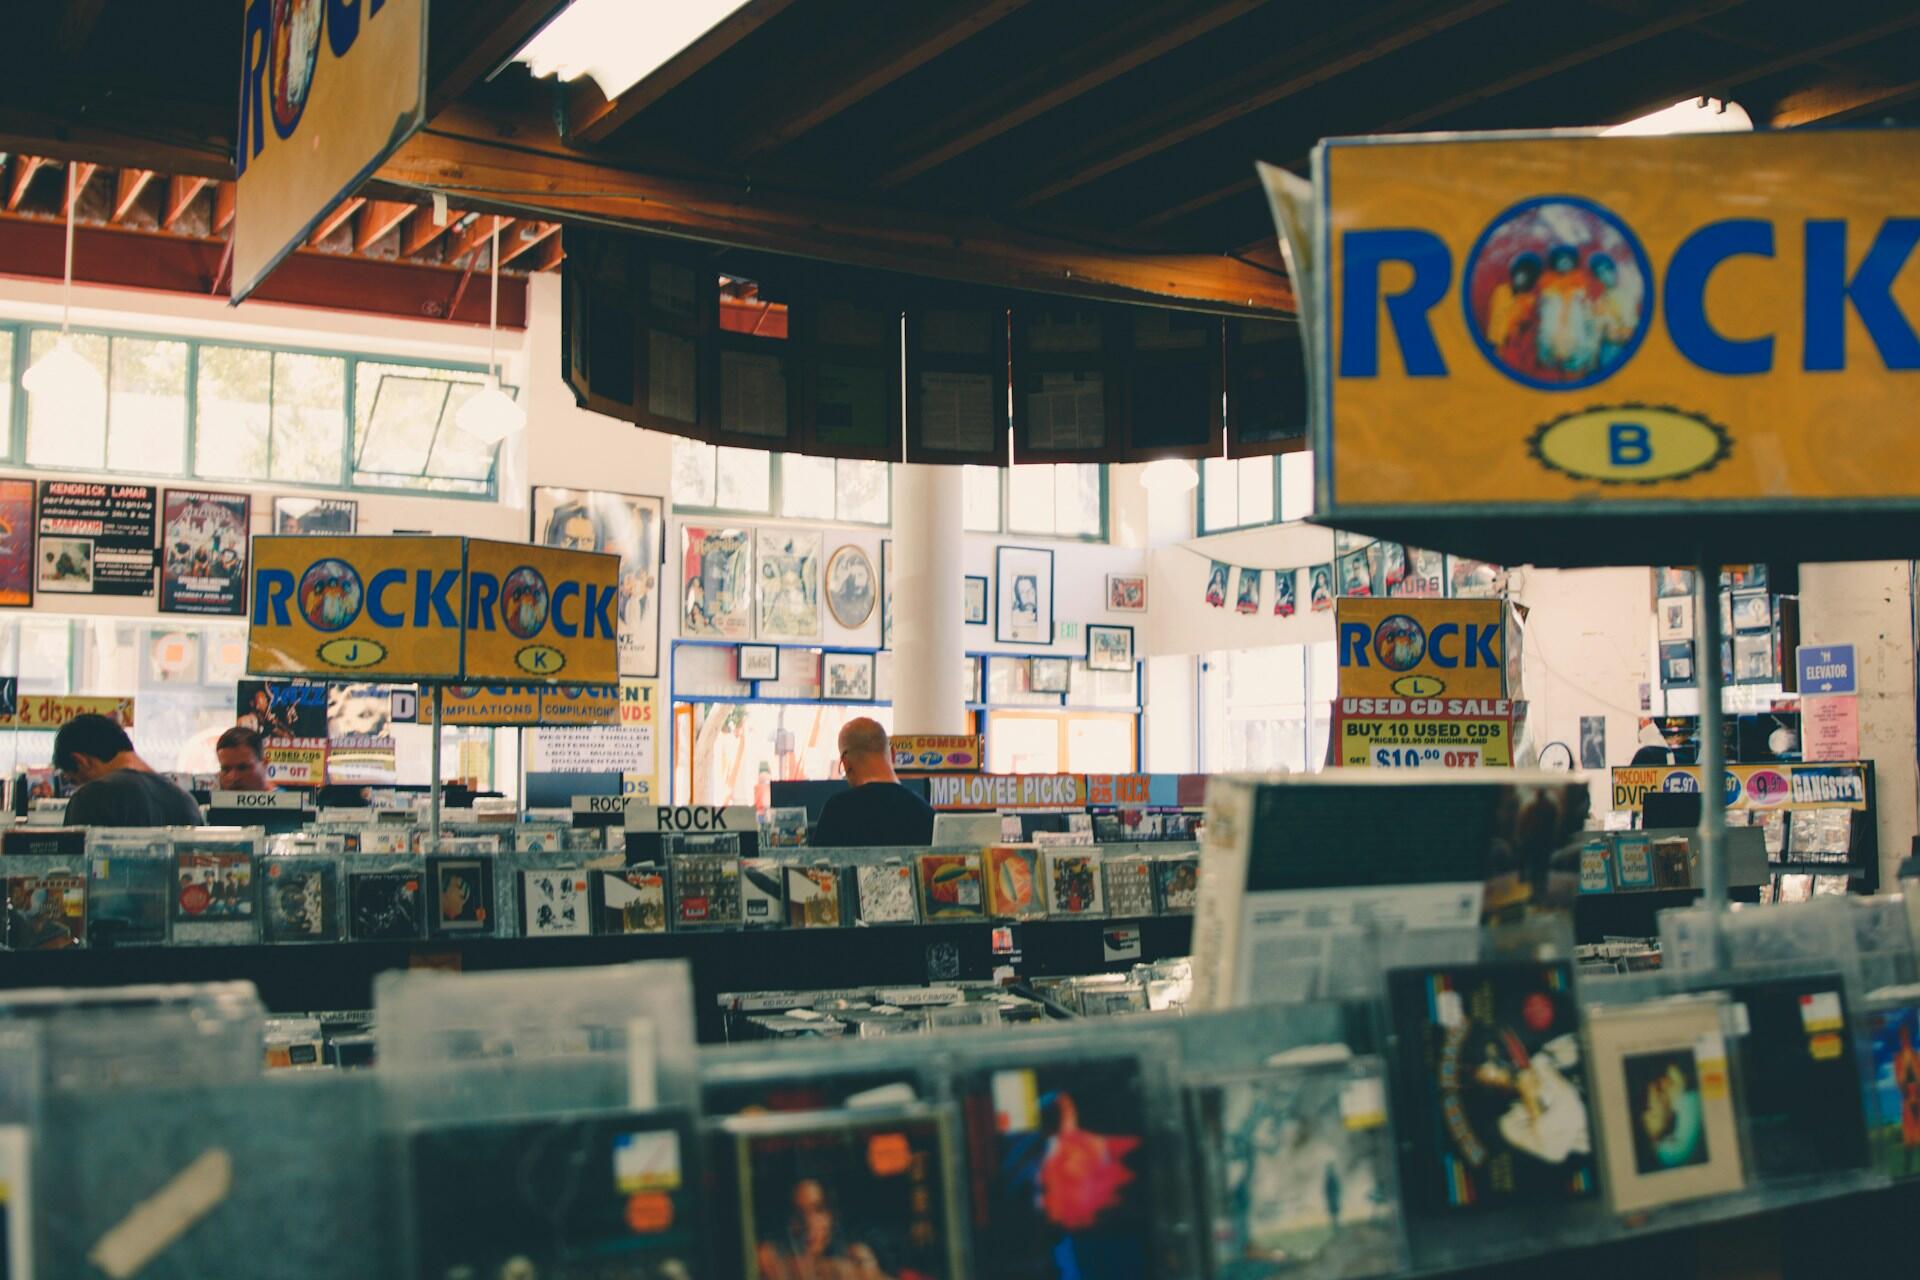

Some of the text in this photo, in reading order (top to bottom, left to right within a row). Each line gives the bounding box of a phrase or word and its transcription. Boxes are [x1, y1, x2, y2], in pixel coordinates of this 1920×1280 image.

[1340, 195, 1920, 392] ROCK
[1608, 422, 1653, 467] B
[49, 482, 147, 499] KENDRICK LAMAR
[42, 496, 101, 507] performance
[115, 500, 153, 510] signing
[252, 557, 462, 632] ROCK
[467, 566, 617, 640] ROCK
[1060, 621, 1079, 641] EXIT
[1340, 614, 1500, 672] ROCK
[345, 645, 358, 661] J
[533, 651, 548, 669] K
[1806, 664, 1848, 680] ELEVATOR
[1413, 681, 1424, 693] L
[424, 703, 533, 717] CMPILATIONS
[621, 706, 652, 721] VDS
[1342, 698, 1510, 716] USED CD SALE
[1346, 723, 1501, 737] BUY 10 USED CDS
[294, 737, 326, 748] SALE
[916, 737, 976, 749] COMEDY
[1443, 751, 1479, 767] OFF
[1614, 770, 1657, 784] DISCOUNT
[1023, 777, 1077, 804] PICKS
[1115, 775, 1152, 803] ROCK
[1792, 774, 1863, 804] GANGSTER
[237, 794, 276, 807] ROCK
[590, 796, 631, 813] ROCK
[657, 807, 728, 830] ROCK
